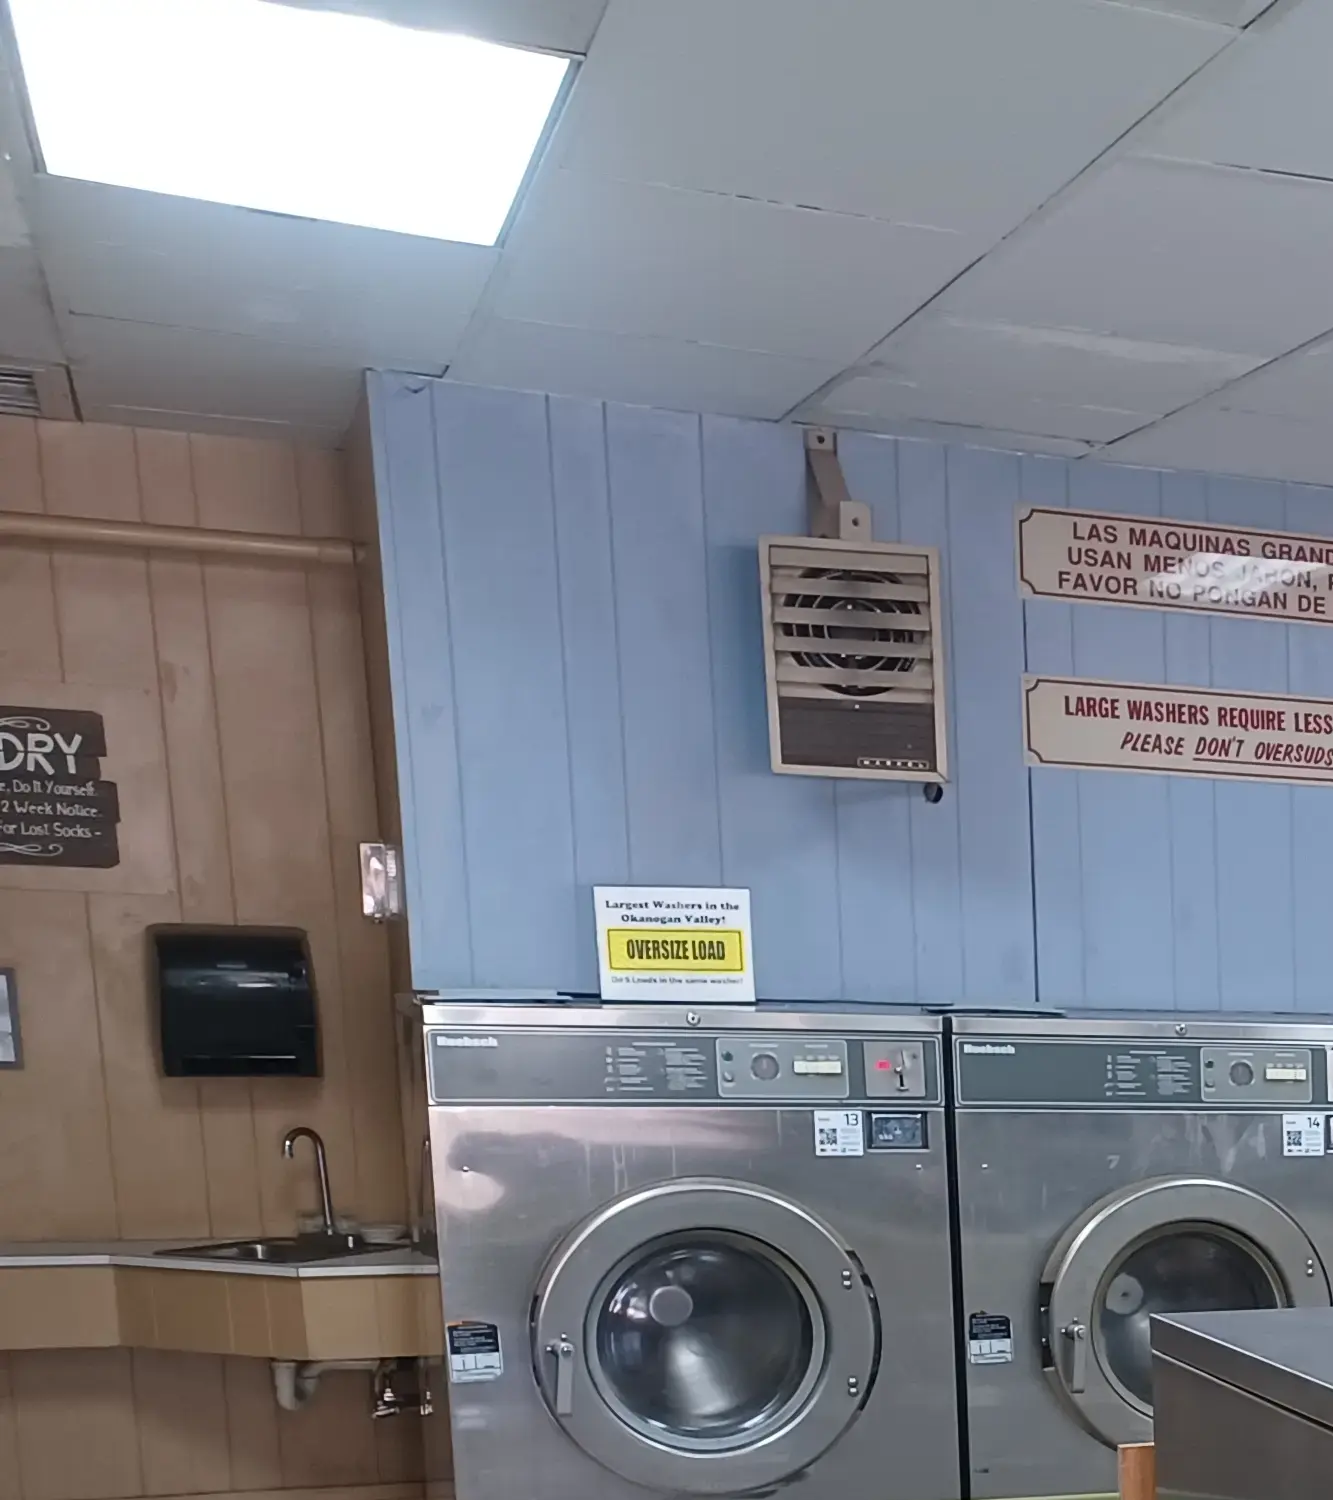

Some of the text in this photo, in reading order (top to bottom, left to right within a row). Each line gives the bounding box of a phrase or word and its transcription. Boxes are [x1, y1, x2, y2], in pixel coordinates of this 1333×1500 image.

[1072, 522, 1119, 545] LAS
[1128, 528, 1251, 557] MAQUINAS
[1067, 546, 1132, 571] USAN
[1144, 554, 1225, 579] MENOS
[1058, 571, 1138, 596] FAVOR
[1150, 579, 1182, 600] NO
[1193, 585, 1287, 610] PONGAN
[1298, 594, 1326, 614] DE
[1064, 695, 1121, 720] LARGE
[1126, 700, 1210, 726] WASHERS
[1217, 708, 1286, 732] REQUIRE
[1294, 712, 1333, 735] LESS
[1120, 732, 1185, 756] PLEASE
[1195, 736, 1245, 760] DON'T
[13, 779, 31, 793] Do
[13, 801, 53, 815] Week
[20, 821, 49, 836] Lost
[53, 822, 93, 838] Socks
[605, 900, 739, 910] Largest Washers in the
[621, 914, 681, 925] Okanogan
[626, 939, 726, 961] OVERSIZE LOAD
[843, 1113, 859, 1126] 13
[1307, 1117, 1320, 1128] 14
